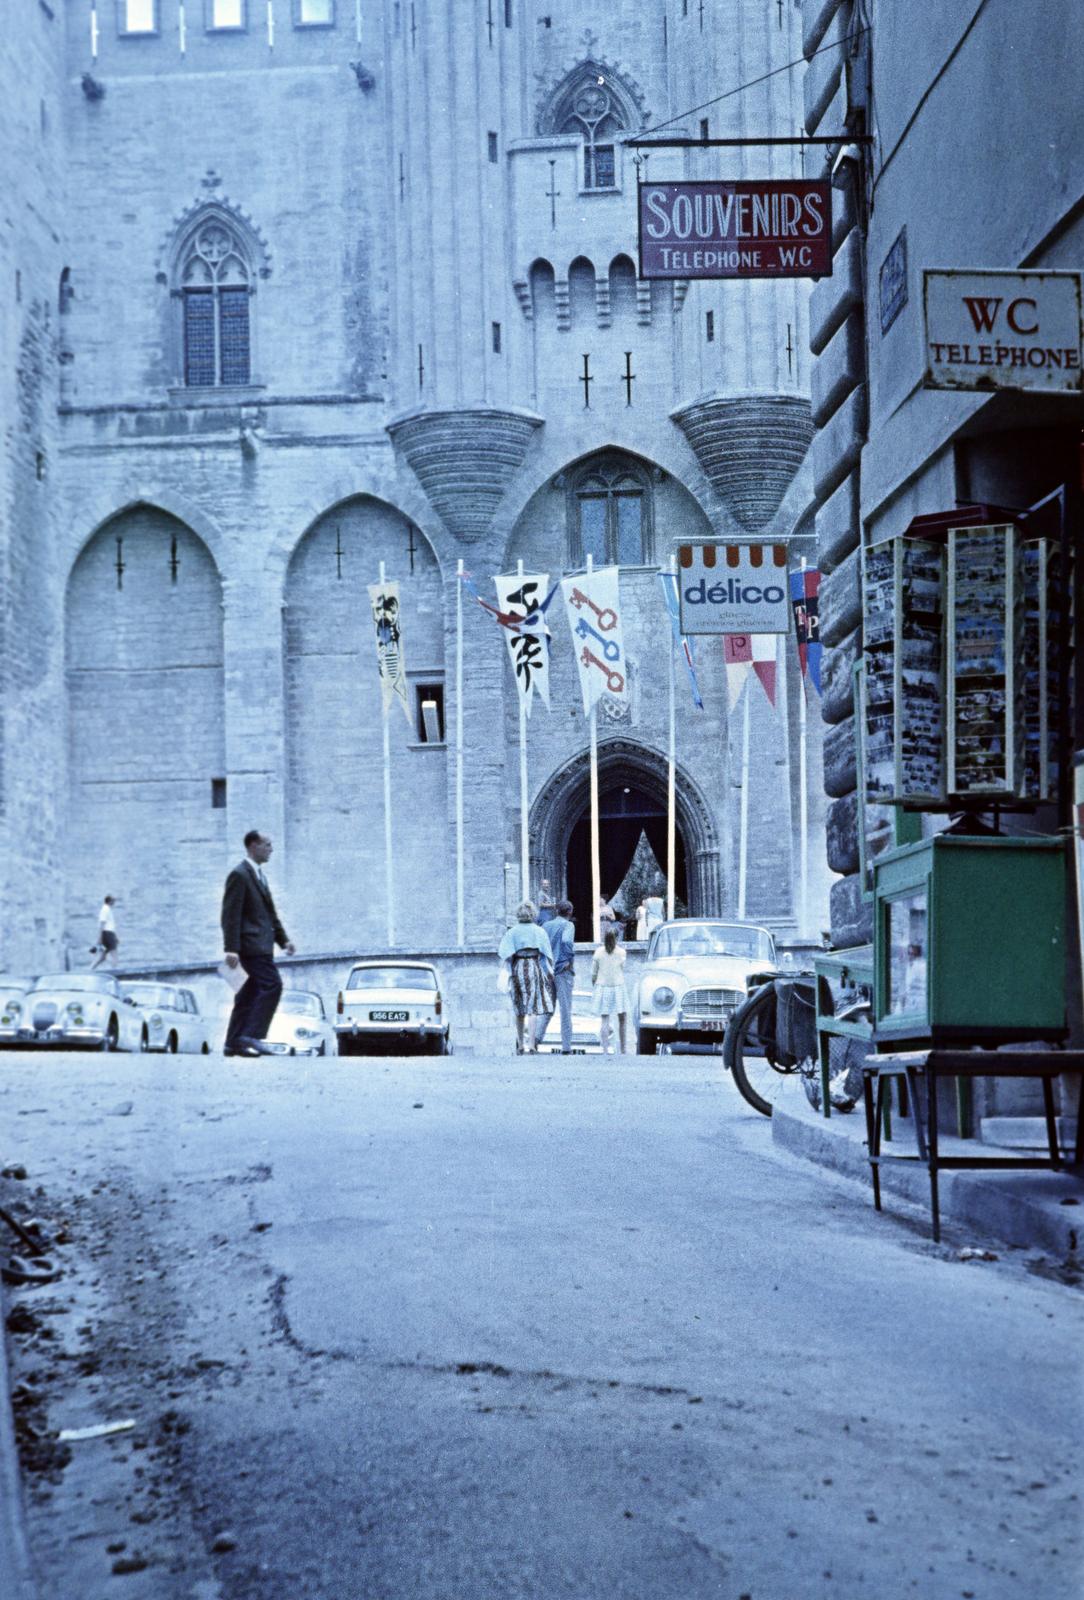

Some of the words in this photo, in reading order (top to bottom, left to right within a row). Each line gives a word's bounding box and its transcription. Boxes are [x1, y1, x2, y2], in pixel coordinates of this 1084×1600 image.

[646, 191, 824, 239] SOUVENIRS
[961, 297, 1040, 336] WC
[929, 343, 1081, 370] TELEPHONE
[684, 578, 785, 605] délico
